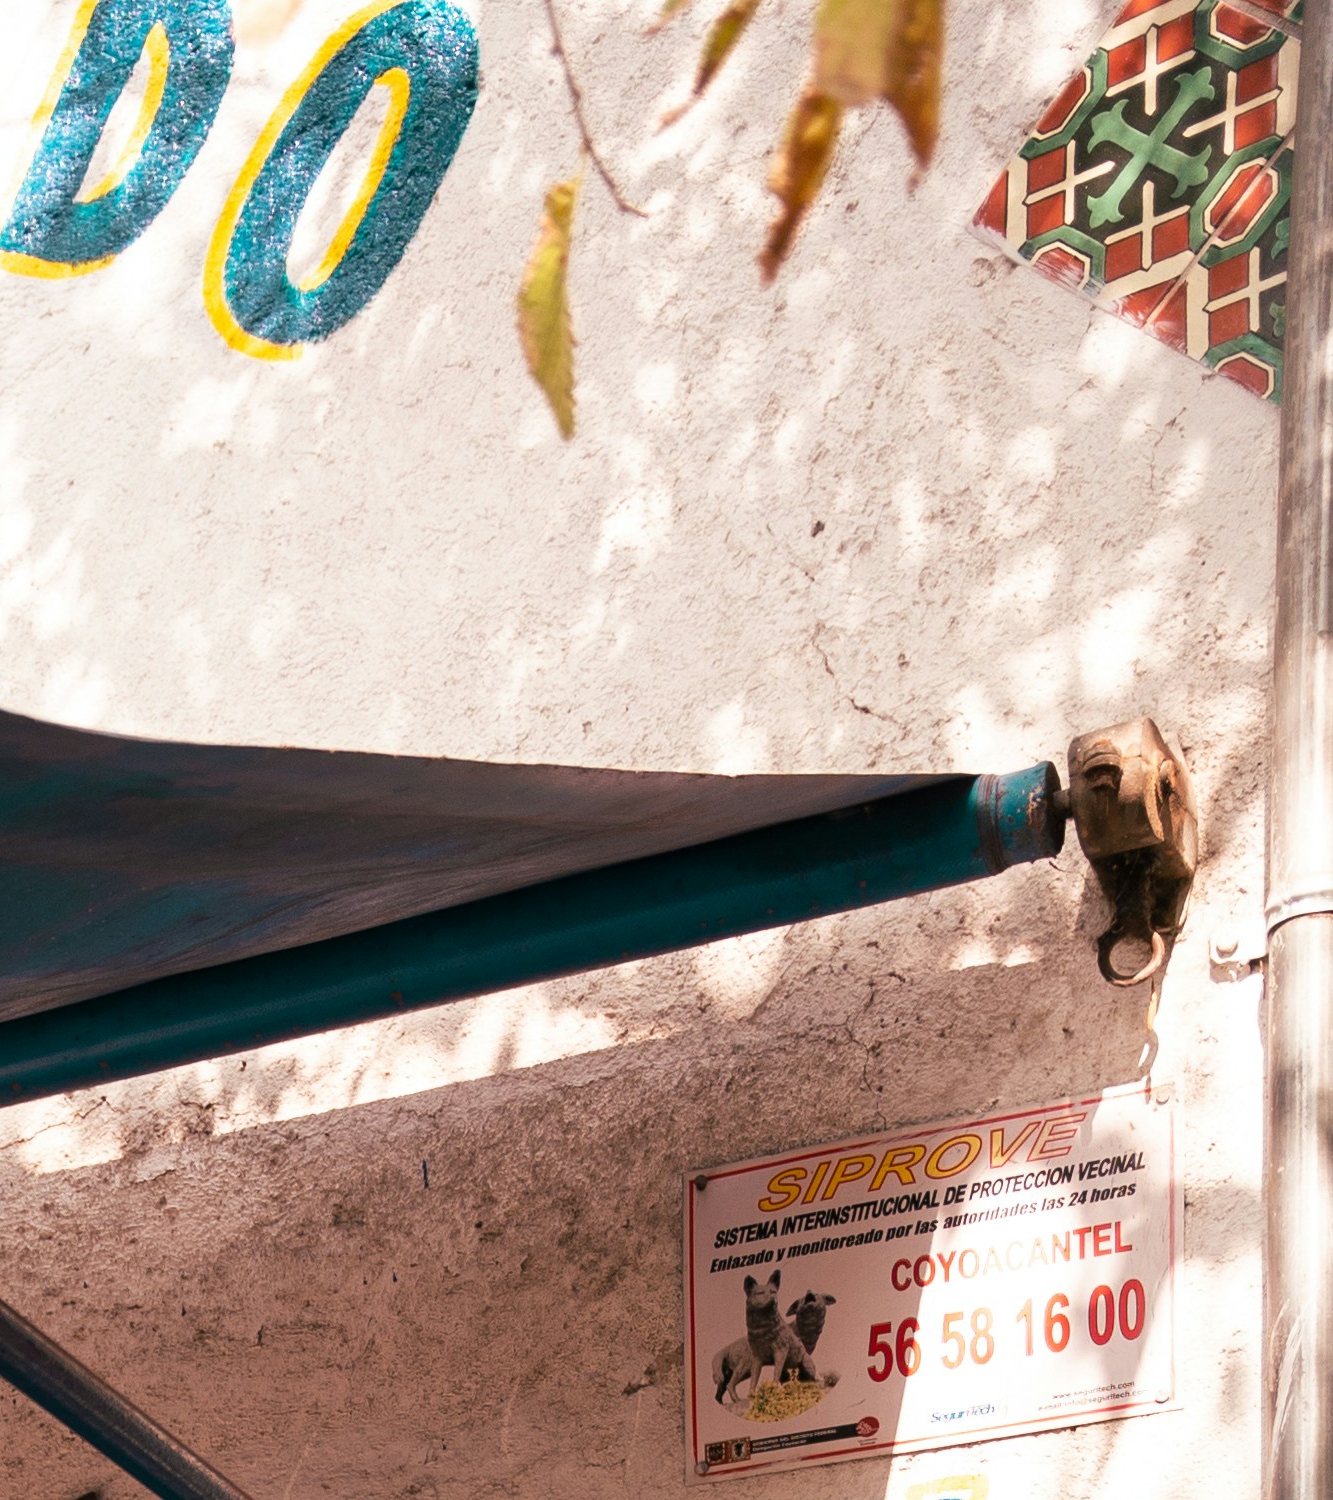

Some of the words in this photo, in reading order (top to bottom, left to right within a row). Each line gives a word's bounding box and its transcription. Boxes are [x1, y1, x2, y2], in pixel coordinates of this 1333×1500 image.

[713, 1218, 778, 1249] SISTEMA
[781, 1192, 940, 1236] INTERINSTITUCIONAL
[942, 1184, 968, 1206] DE
[969, 1165, 1076, 1200] PROTECCION
[1078, 1151, 1146, 1180] VECINAL
[758, 1112, 1086, 1212] SIPROVE
[710, 1250, 773, 1273] Enlazado
[776, 1248, 786, 1262] y
[787, 1229, 883, 1257] monitoreado
[885, 1222, 914, 1242] por
[914, 1217, 938, 1235] las
[943, 1200, 1037, 1230] autoridades
[1041, 1195, 1066, 1212] las
[1068, 1190, 1088, 1207] 24
[1090, 1182, 1137, 1203] horas
[891, 1221, 1133, 1293] COYOACANTEL
[866, 1317, 921, 1383] 56
[941, 1308, 995, 1370] 58
[1016, 1291, 1072, 1358] 16
[1088, 1278, 1146, 1347] 00
